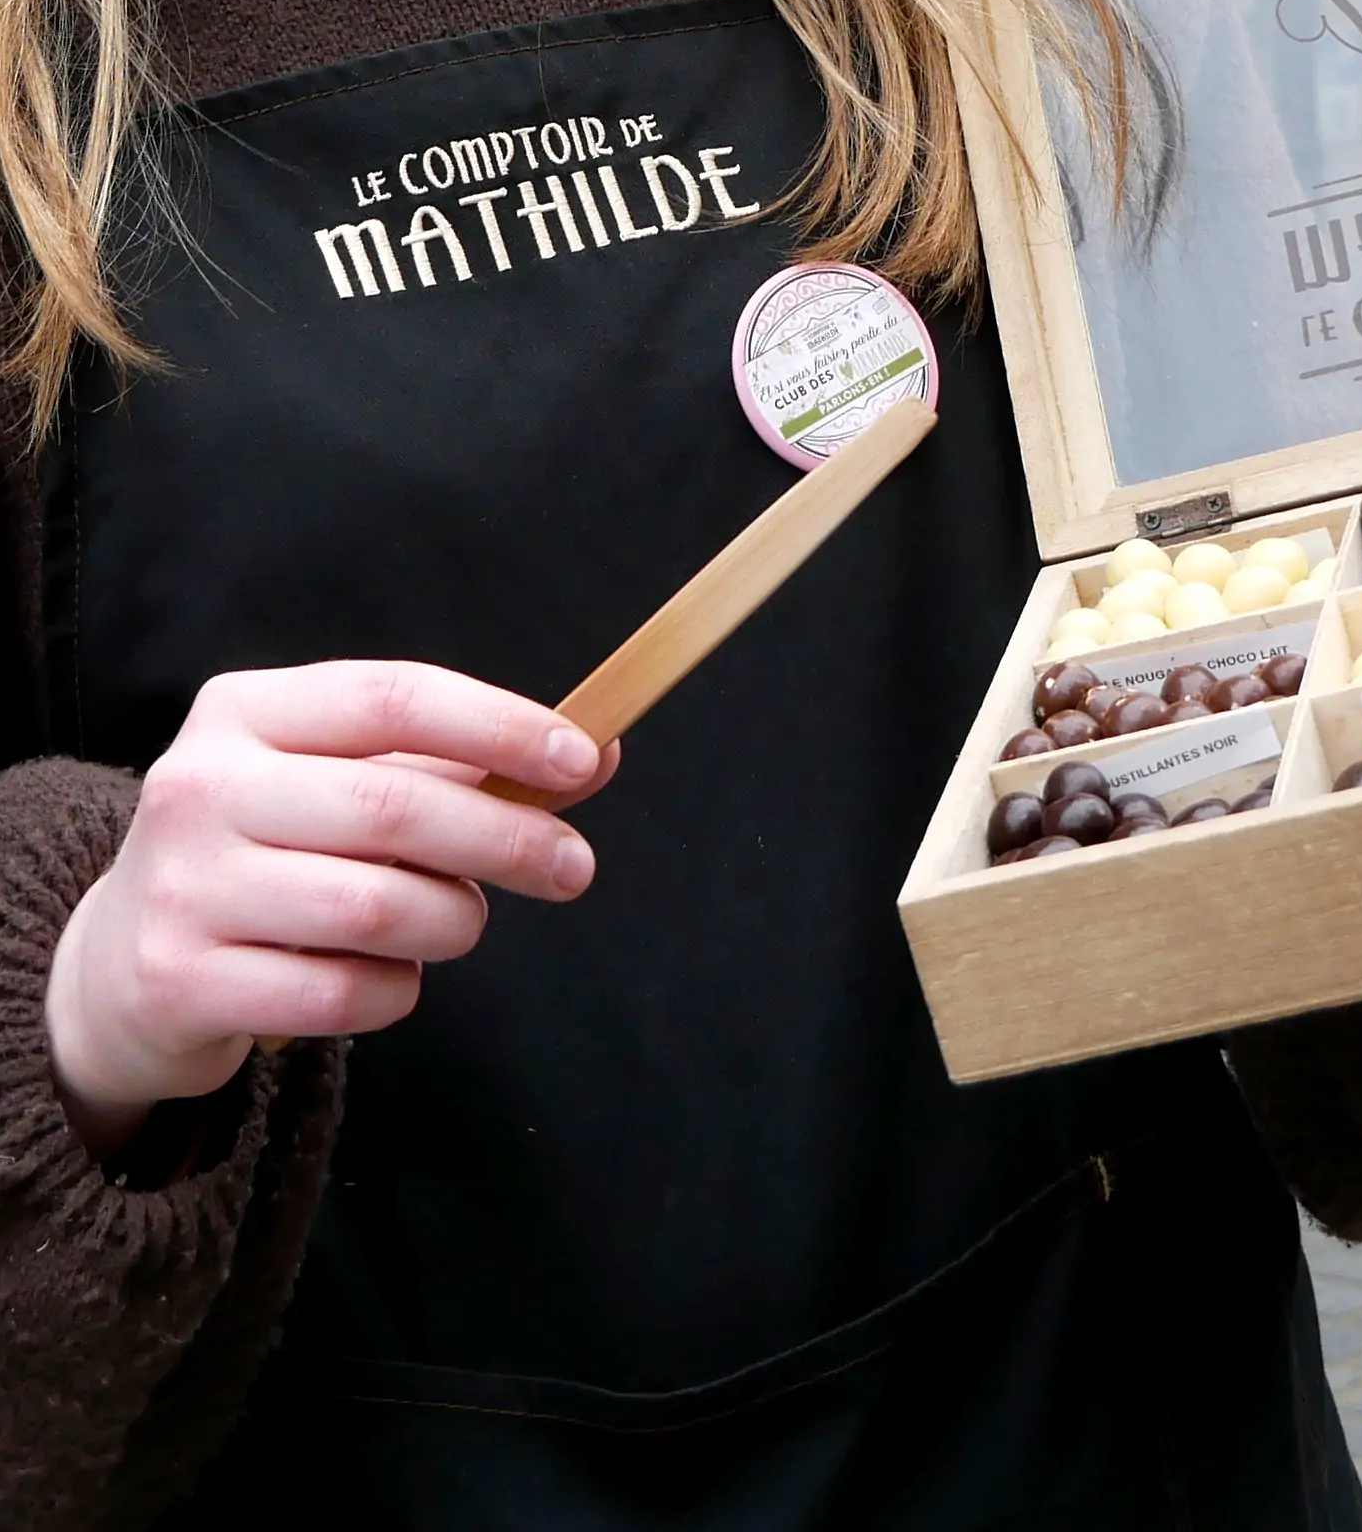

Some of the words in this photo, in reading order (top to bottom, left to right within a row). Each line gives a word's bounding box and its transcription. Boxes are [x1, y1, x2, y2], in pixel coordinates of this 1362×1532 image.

[351, 170, 392, 208] LE
[398, 116, 613, 196] COMPTOIR
[619, 113, 663, 148] DE
[313, 146, 761, 299] MATHILDE
[786, 367, 811, 386] vous
[850, 325, 882, 354] partie
[883, 315, 898, 330] du
[774, 385, 807, 410] CLUB
[808, 369, 834, 391] DES
[1206, 651, 1258, 670] CHOCO
[1258, 644, 1289, 661] LAIT
[1107, 747, 1202, 790] USTILLANTES
[1203, 733, 1240, 755] NOIR
